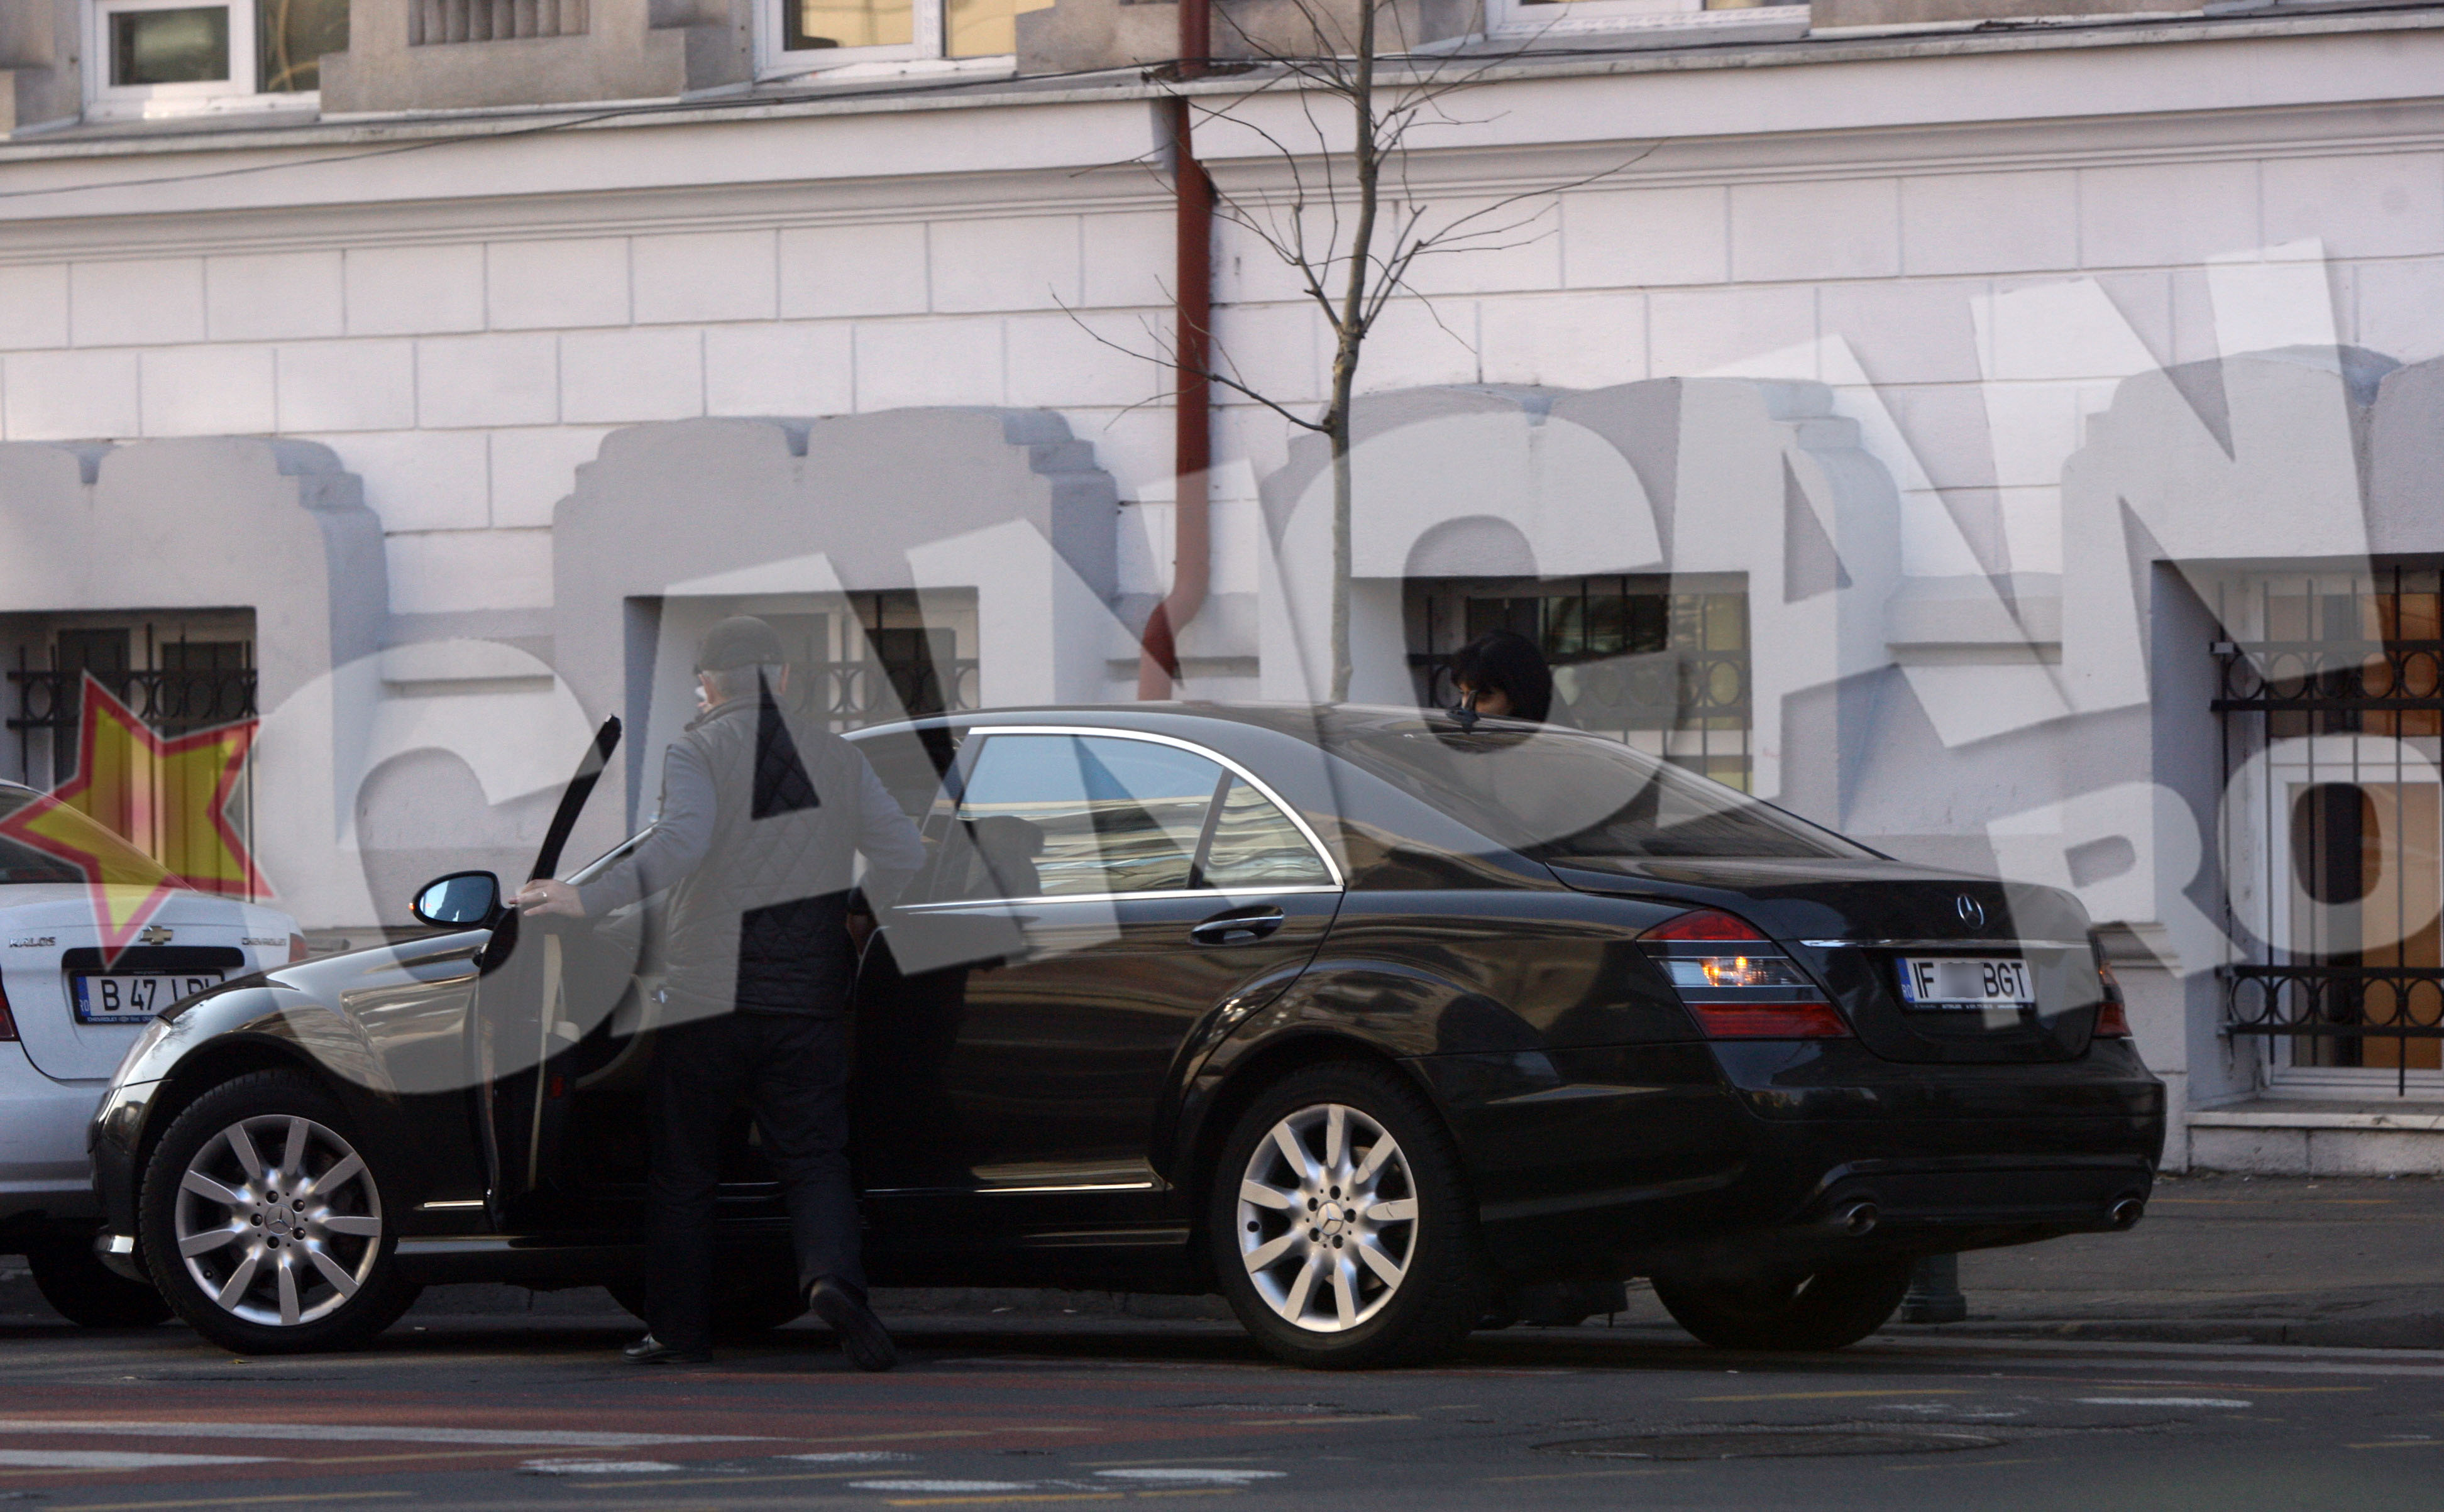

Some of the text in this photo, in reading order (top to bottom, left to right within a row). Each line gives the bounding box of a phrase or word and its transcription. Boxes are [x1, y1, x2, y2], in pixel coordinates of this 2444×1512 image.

[9, 936, 56, 947] KALOS
[101, 978, 121, 1011] B
[130, 978, 157, 1011] 47
[1913, 961, 1934, 999] IF
[1983, 961, 2025, 998] BGT
